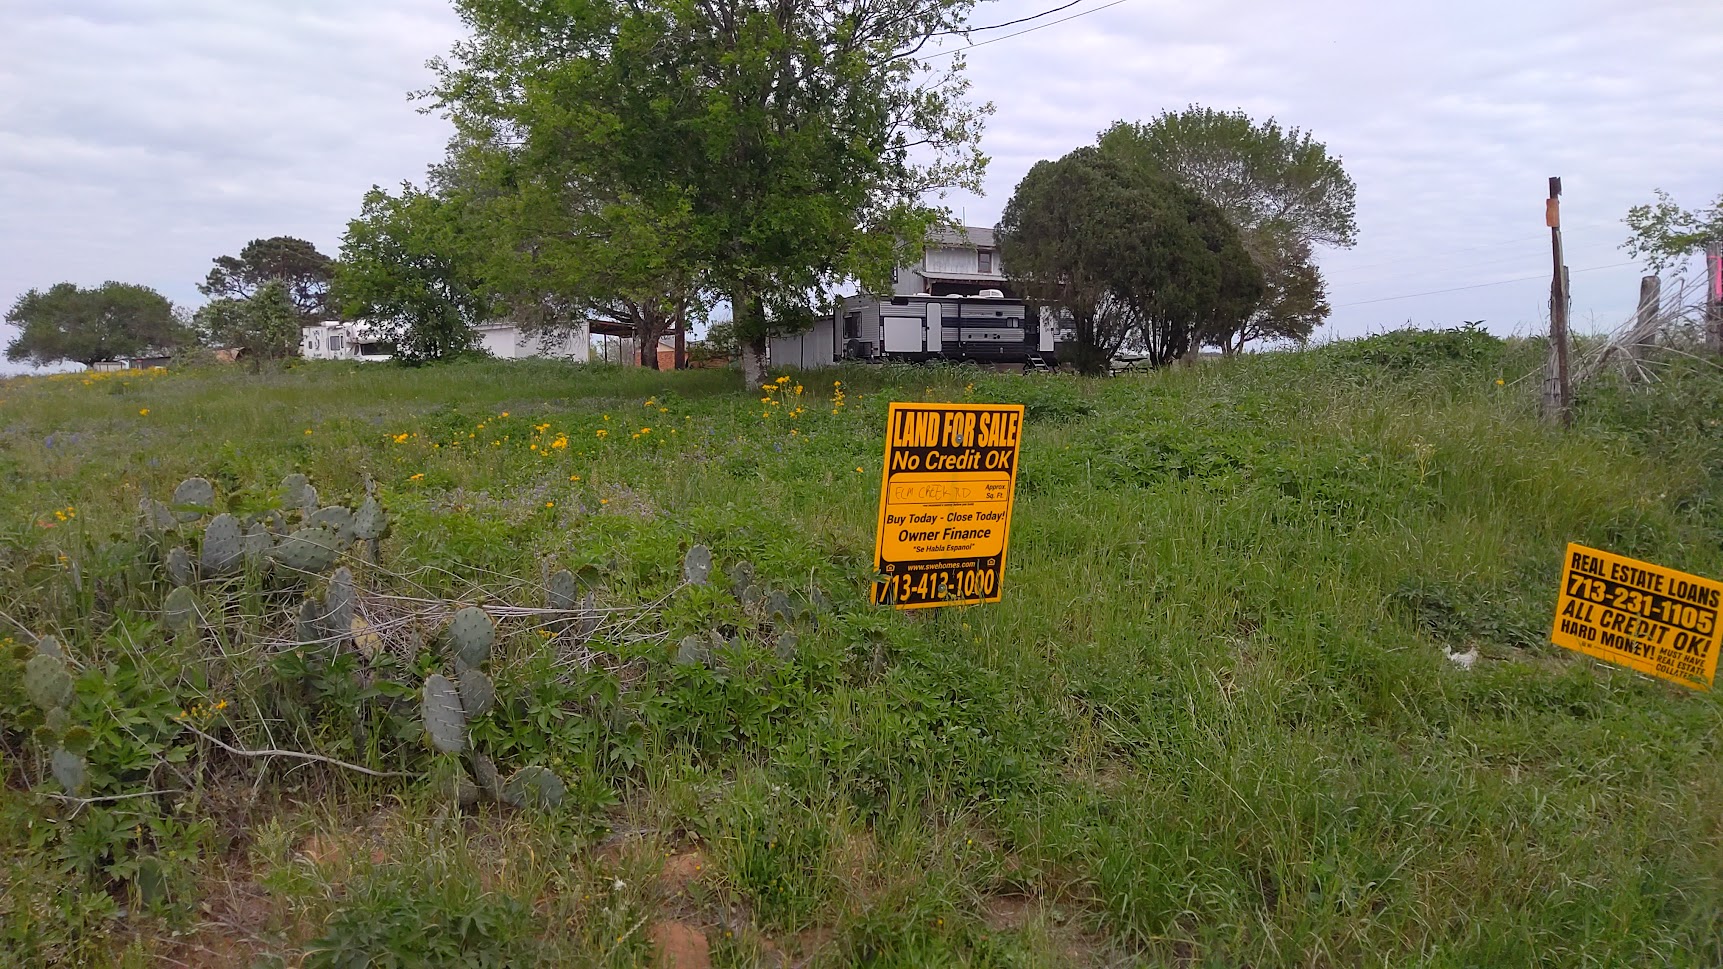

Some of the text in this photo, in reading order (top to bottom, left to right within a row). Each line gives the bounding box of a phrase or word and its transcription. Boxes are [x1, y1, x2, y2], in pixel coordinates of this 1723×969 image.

[893, 411, 1018, 448] LAND FOR SALE
[892, 449, 1013, 470] No Credit OK
[886, 514, 906, 526] Buy
[909, 512, 938, 524] Today
[946, 511, 973, 523] Close
[975, 511, 1006, 523] Today!
[898, 527, 991, 542] Owner Finance
[925, 544, 945, 552] Habla
[907, 560, 976, 572] www.swehomes.com
[879, 568, 995, 603] 713-413-1000
[1571, 552, 1721, 608] REAL ESTATE LOANS
[1569, 574, 1714, 634] 713-231-1105
[1560, 618, 1656, 660] HARD MONEY!
[1562, 599, 1712, 658] ALL CREDIT OK!
[1656, 654, 1706, 675] REAL ESTATE
[1660, 647, 1706, 667] MUST HAVE
